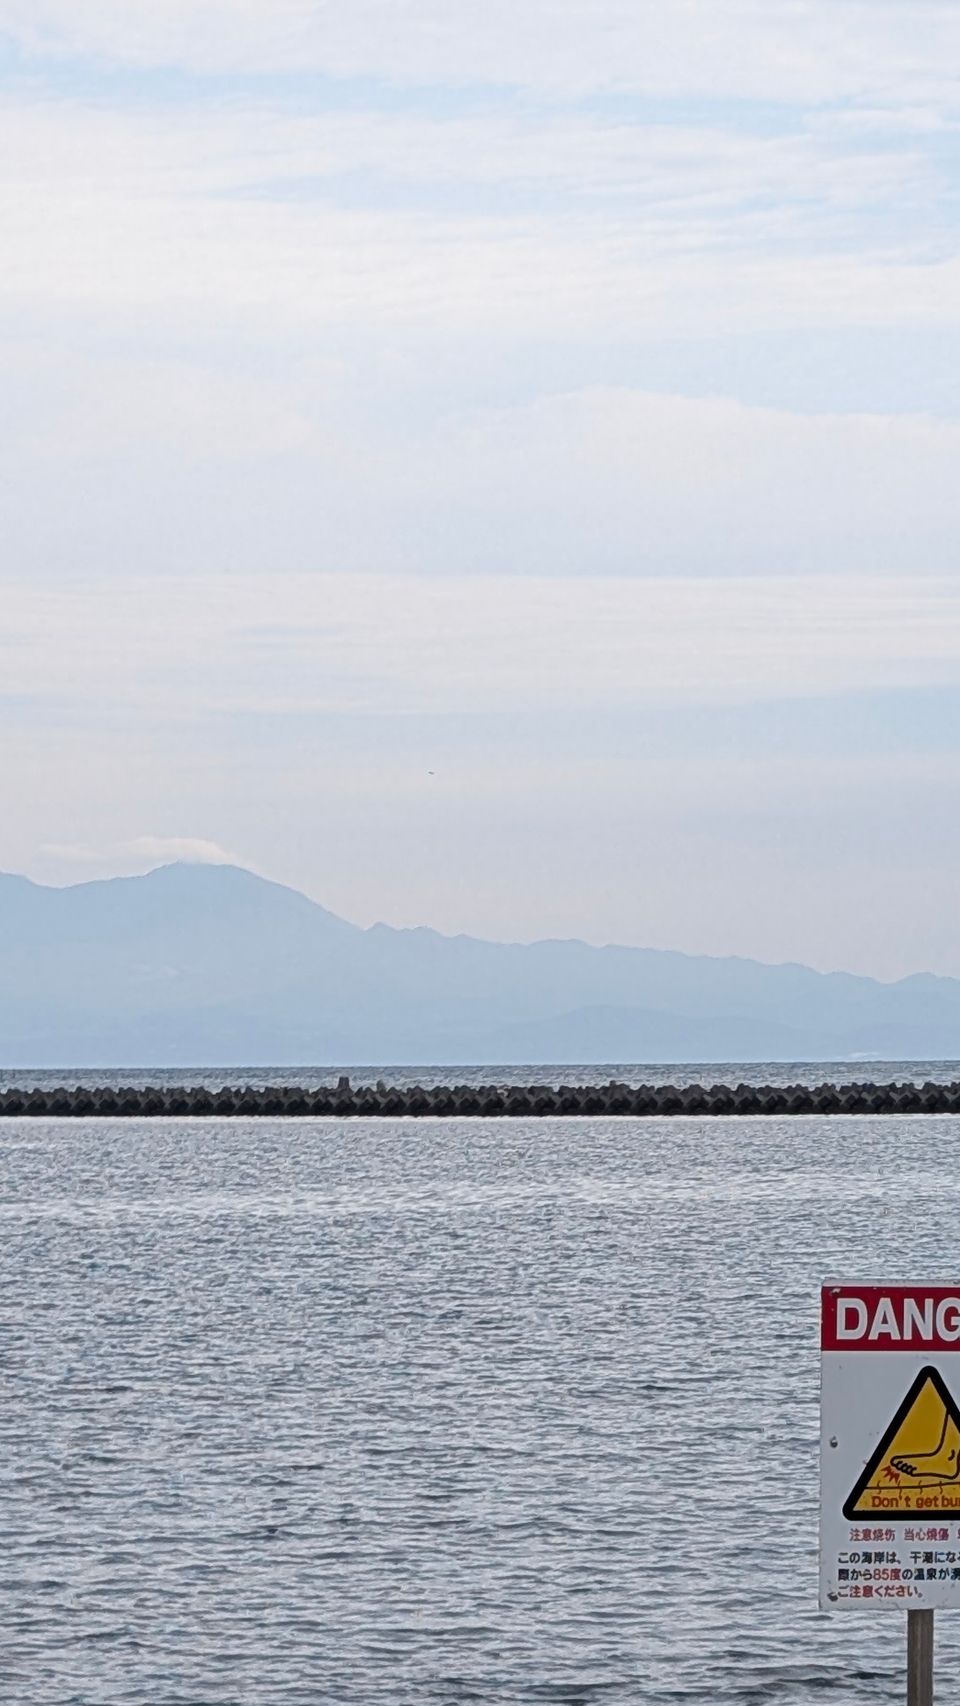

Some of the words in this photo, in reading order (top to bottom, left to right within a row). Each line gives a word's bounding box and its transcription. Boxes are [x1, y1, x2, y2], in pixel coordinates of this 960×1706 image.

[871, 1495, 911, 1507] Don't
[916, 1496, 939, 1508] get
[838, 1585, 924, 1598] ご注意ください。
